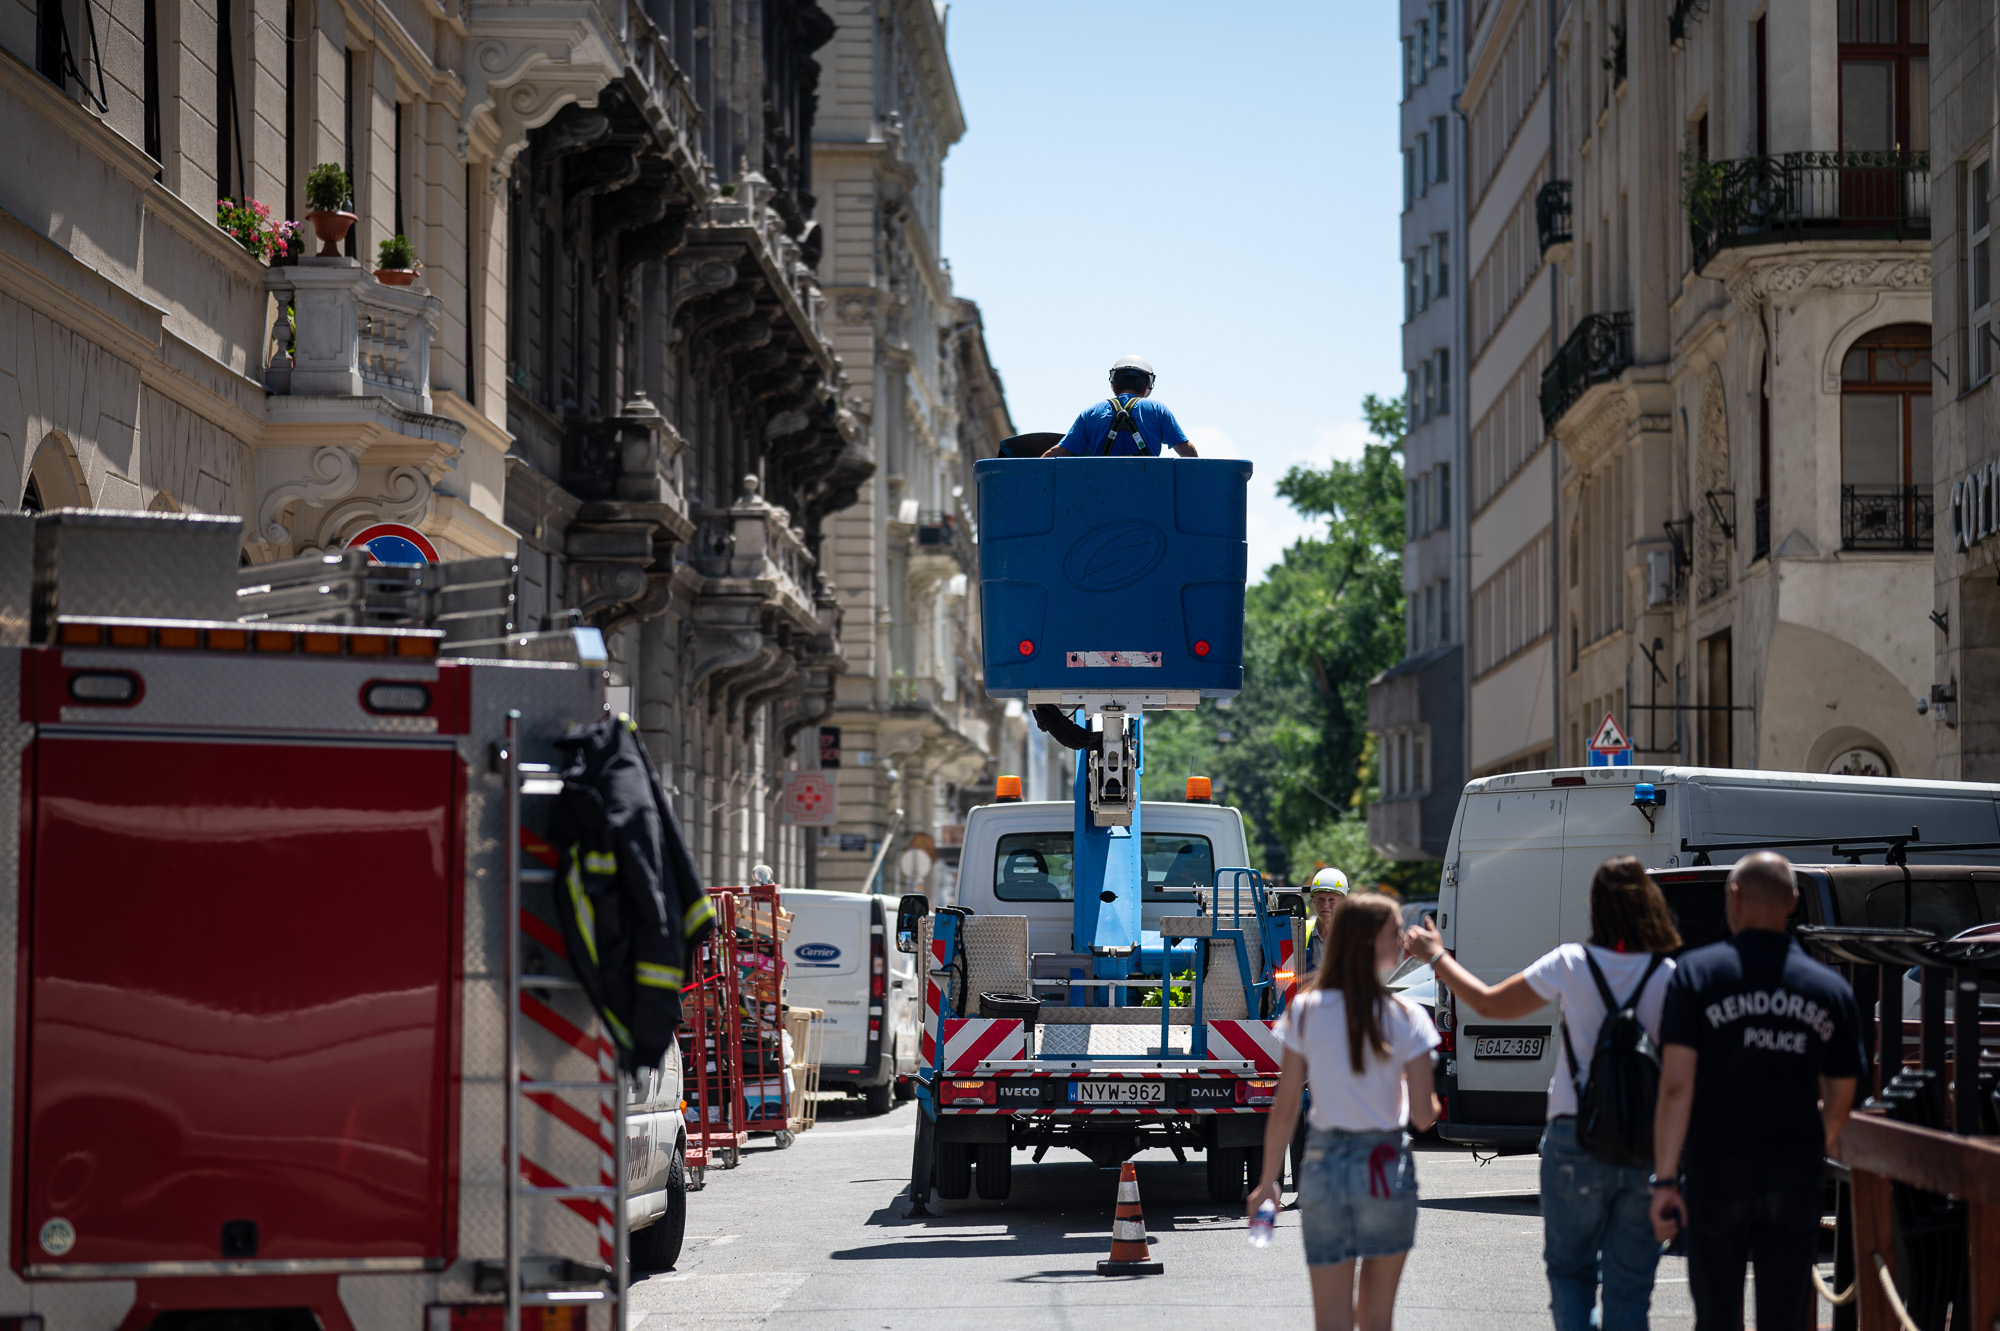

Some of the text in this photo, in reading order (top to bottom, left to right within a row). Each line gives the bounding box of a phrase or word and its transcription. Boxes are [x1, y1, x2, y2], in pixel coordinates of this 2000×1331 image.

[801, 947, 836, 957] Carrier
[1744, 1027, 1807, 1054] POLICE
[1486, 1040, 1540, 1054] GAZ-369
[1000, 1087, 1040, 1097] IVECO
[1081, 1084, 1161, 1100] NYW-962
[1191, 1088, 1231, 1097] DAILY
